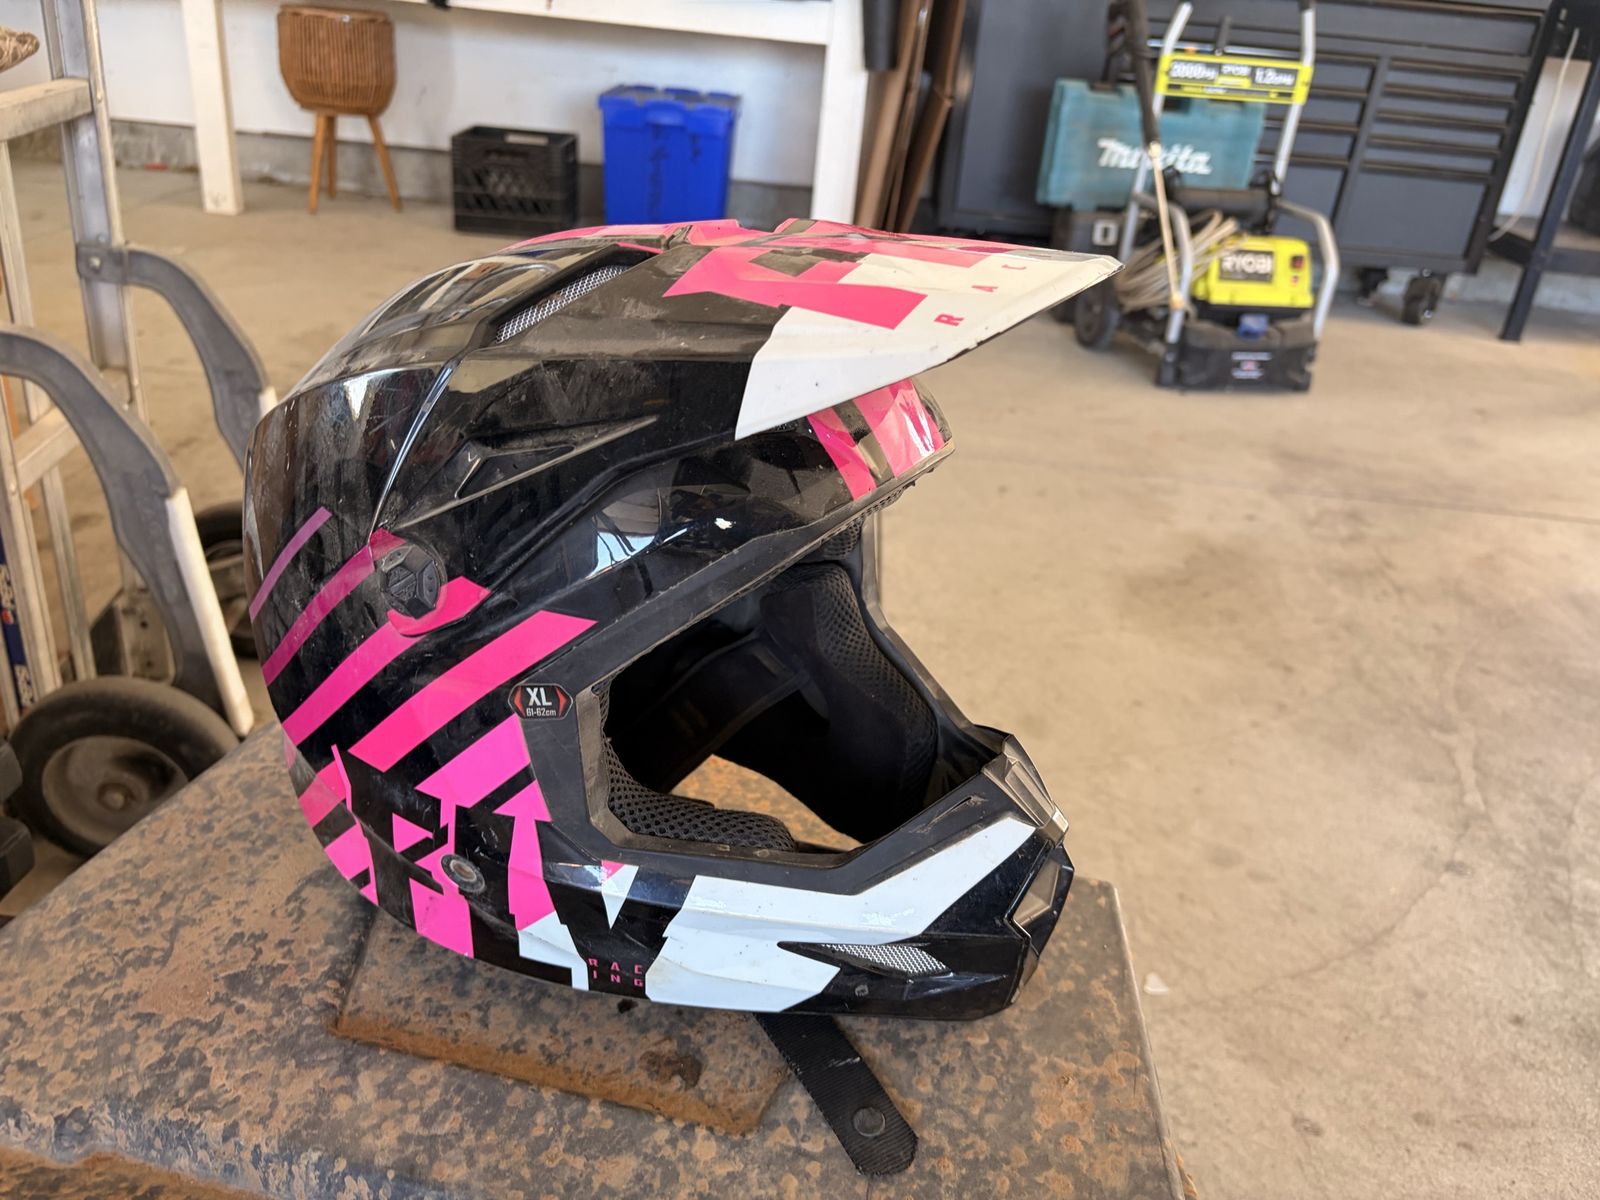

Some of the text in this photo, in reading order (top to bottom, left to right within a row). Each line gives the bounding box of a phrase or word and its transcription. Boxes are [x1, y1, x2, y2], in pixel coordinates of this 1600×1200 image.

[1098, 138, 1212, 175] Maita
[1222, 253, 1272, 274] RYOBI
[526, 687, 552, 706] XL
[526, 708, 557, 717] 61-62cm
